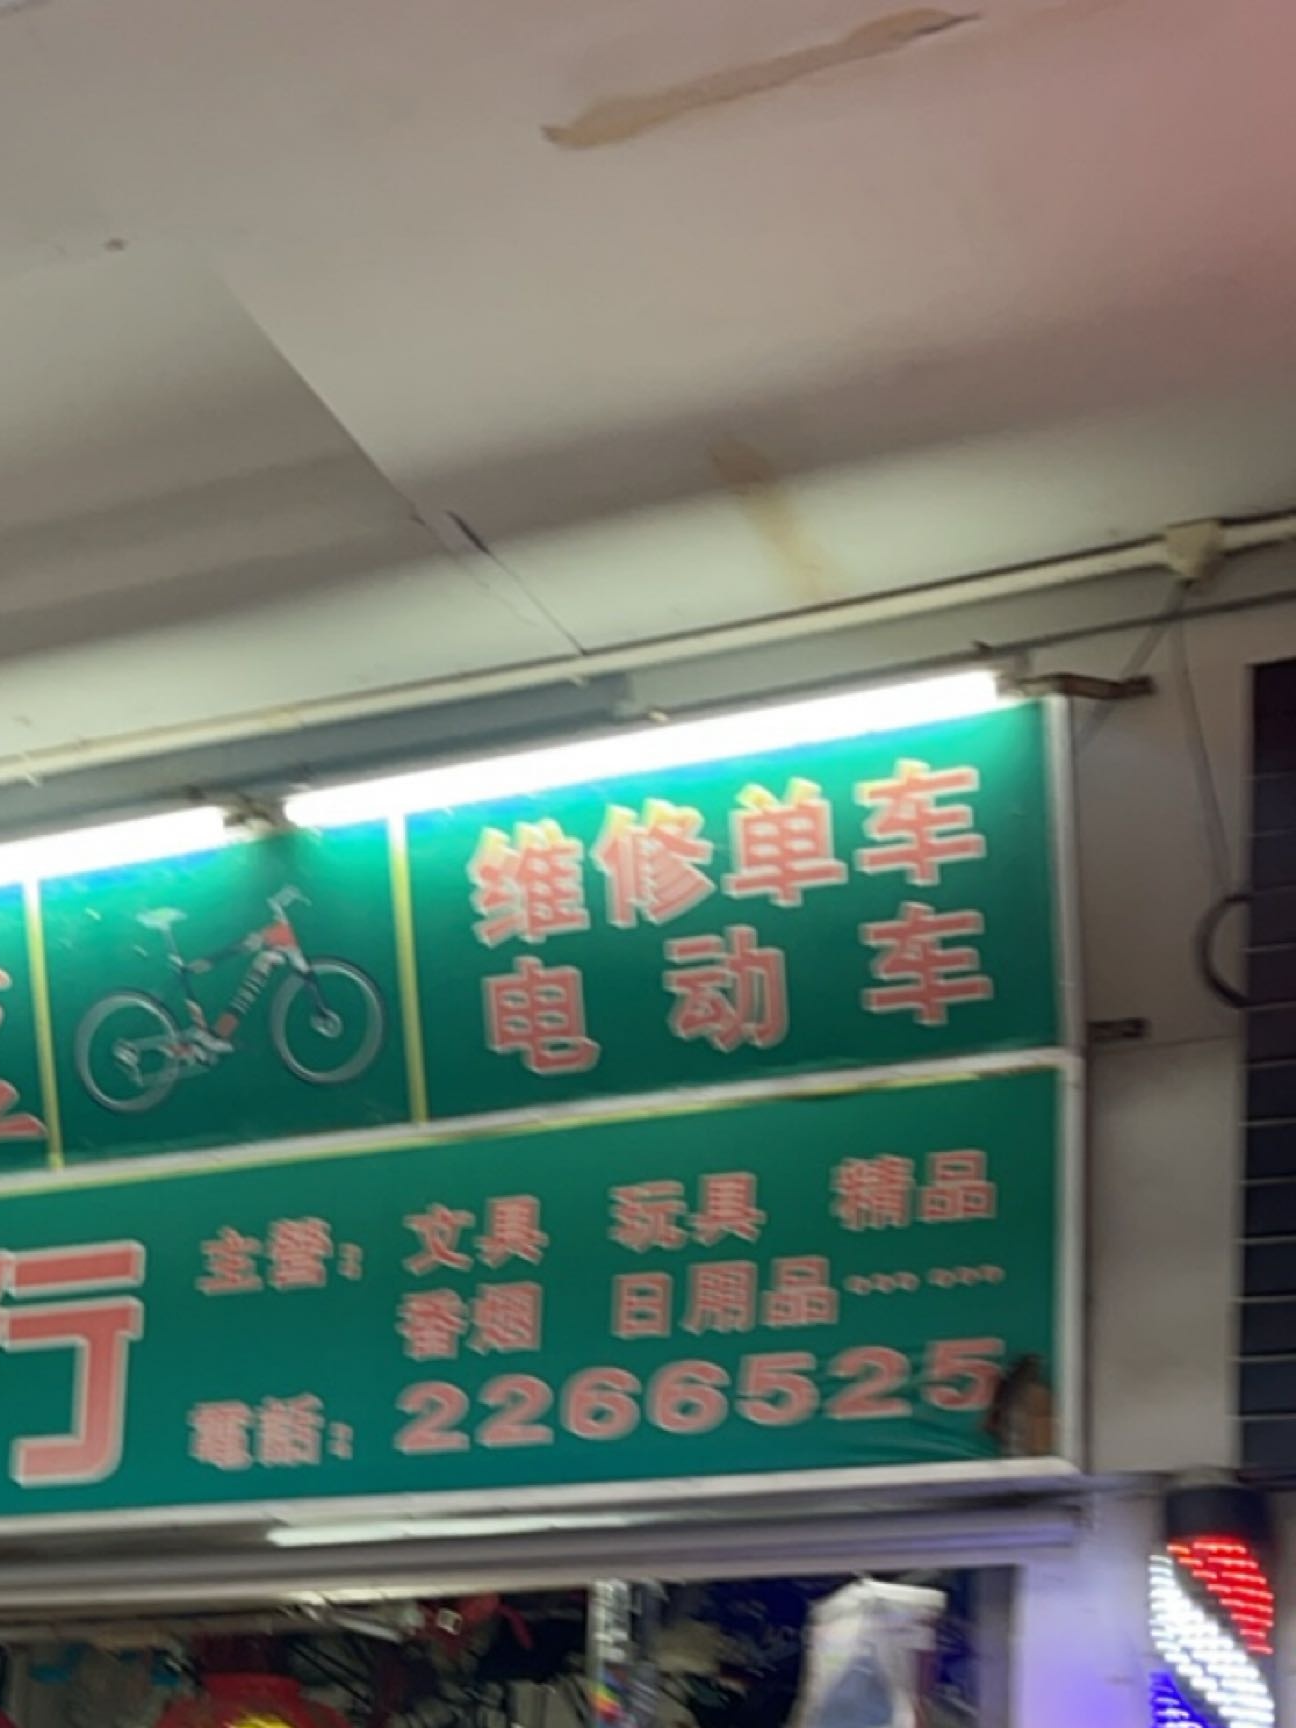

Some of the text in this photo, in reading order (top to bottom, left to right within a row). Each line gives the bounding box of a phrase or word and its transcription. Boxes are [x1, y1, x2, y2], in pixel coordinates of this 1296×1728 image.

[469, 760, 985, 945] 维修单车
[481, 903, 993, 1075] 电动车
[404, 1195, 549, 1275] 文具
[609, 1170, 766, 1252] 玩具
[832, 1149, 996, 1231] 精品
[394, 1337, 1003, 1455] 2266525
